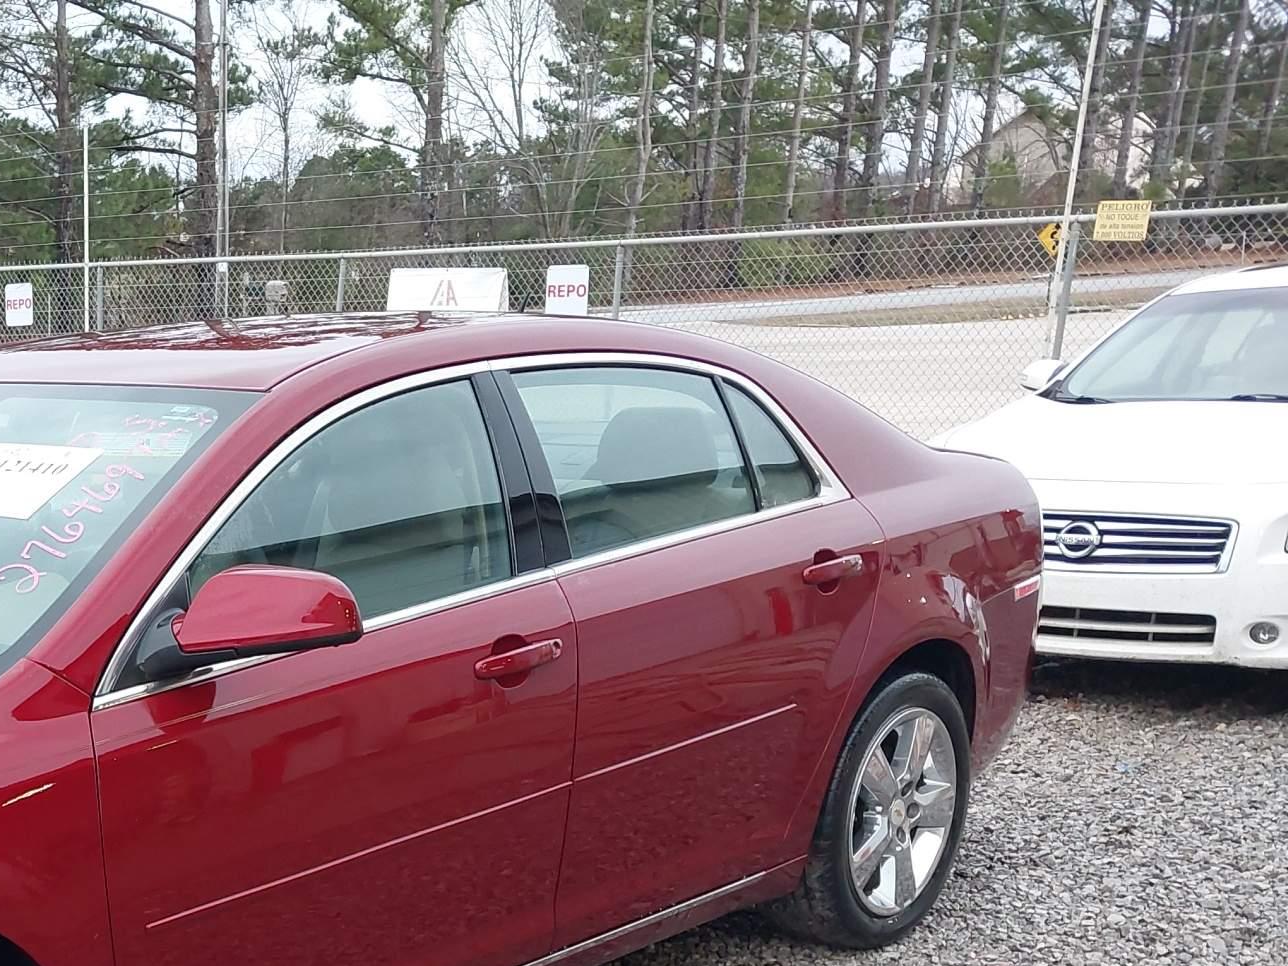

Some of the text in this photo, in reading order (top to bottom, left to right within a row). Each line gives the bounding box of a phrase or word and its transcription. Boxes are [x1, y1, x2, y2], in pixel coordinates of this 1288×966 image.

[1101, 203, 1149, 211] PELIGRO
[1105, 213, 1140, 221] NO TOQUE
[1114, 231, 1145, 240] VOLTIOS
[548, 284, 587, 298] REPO
[6, 298, 32, 310] REPO
[1059, 535, 1094, 544] NISSAN
